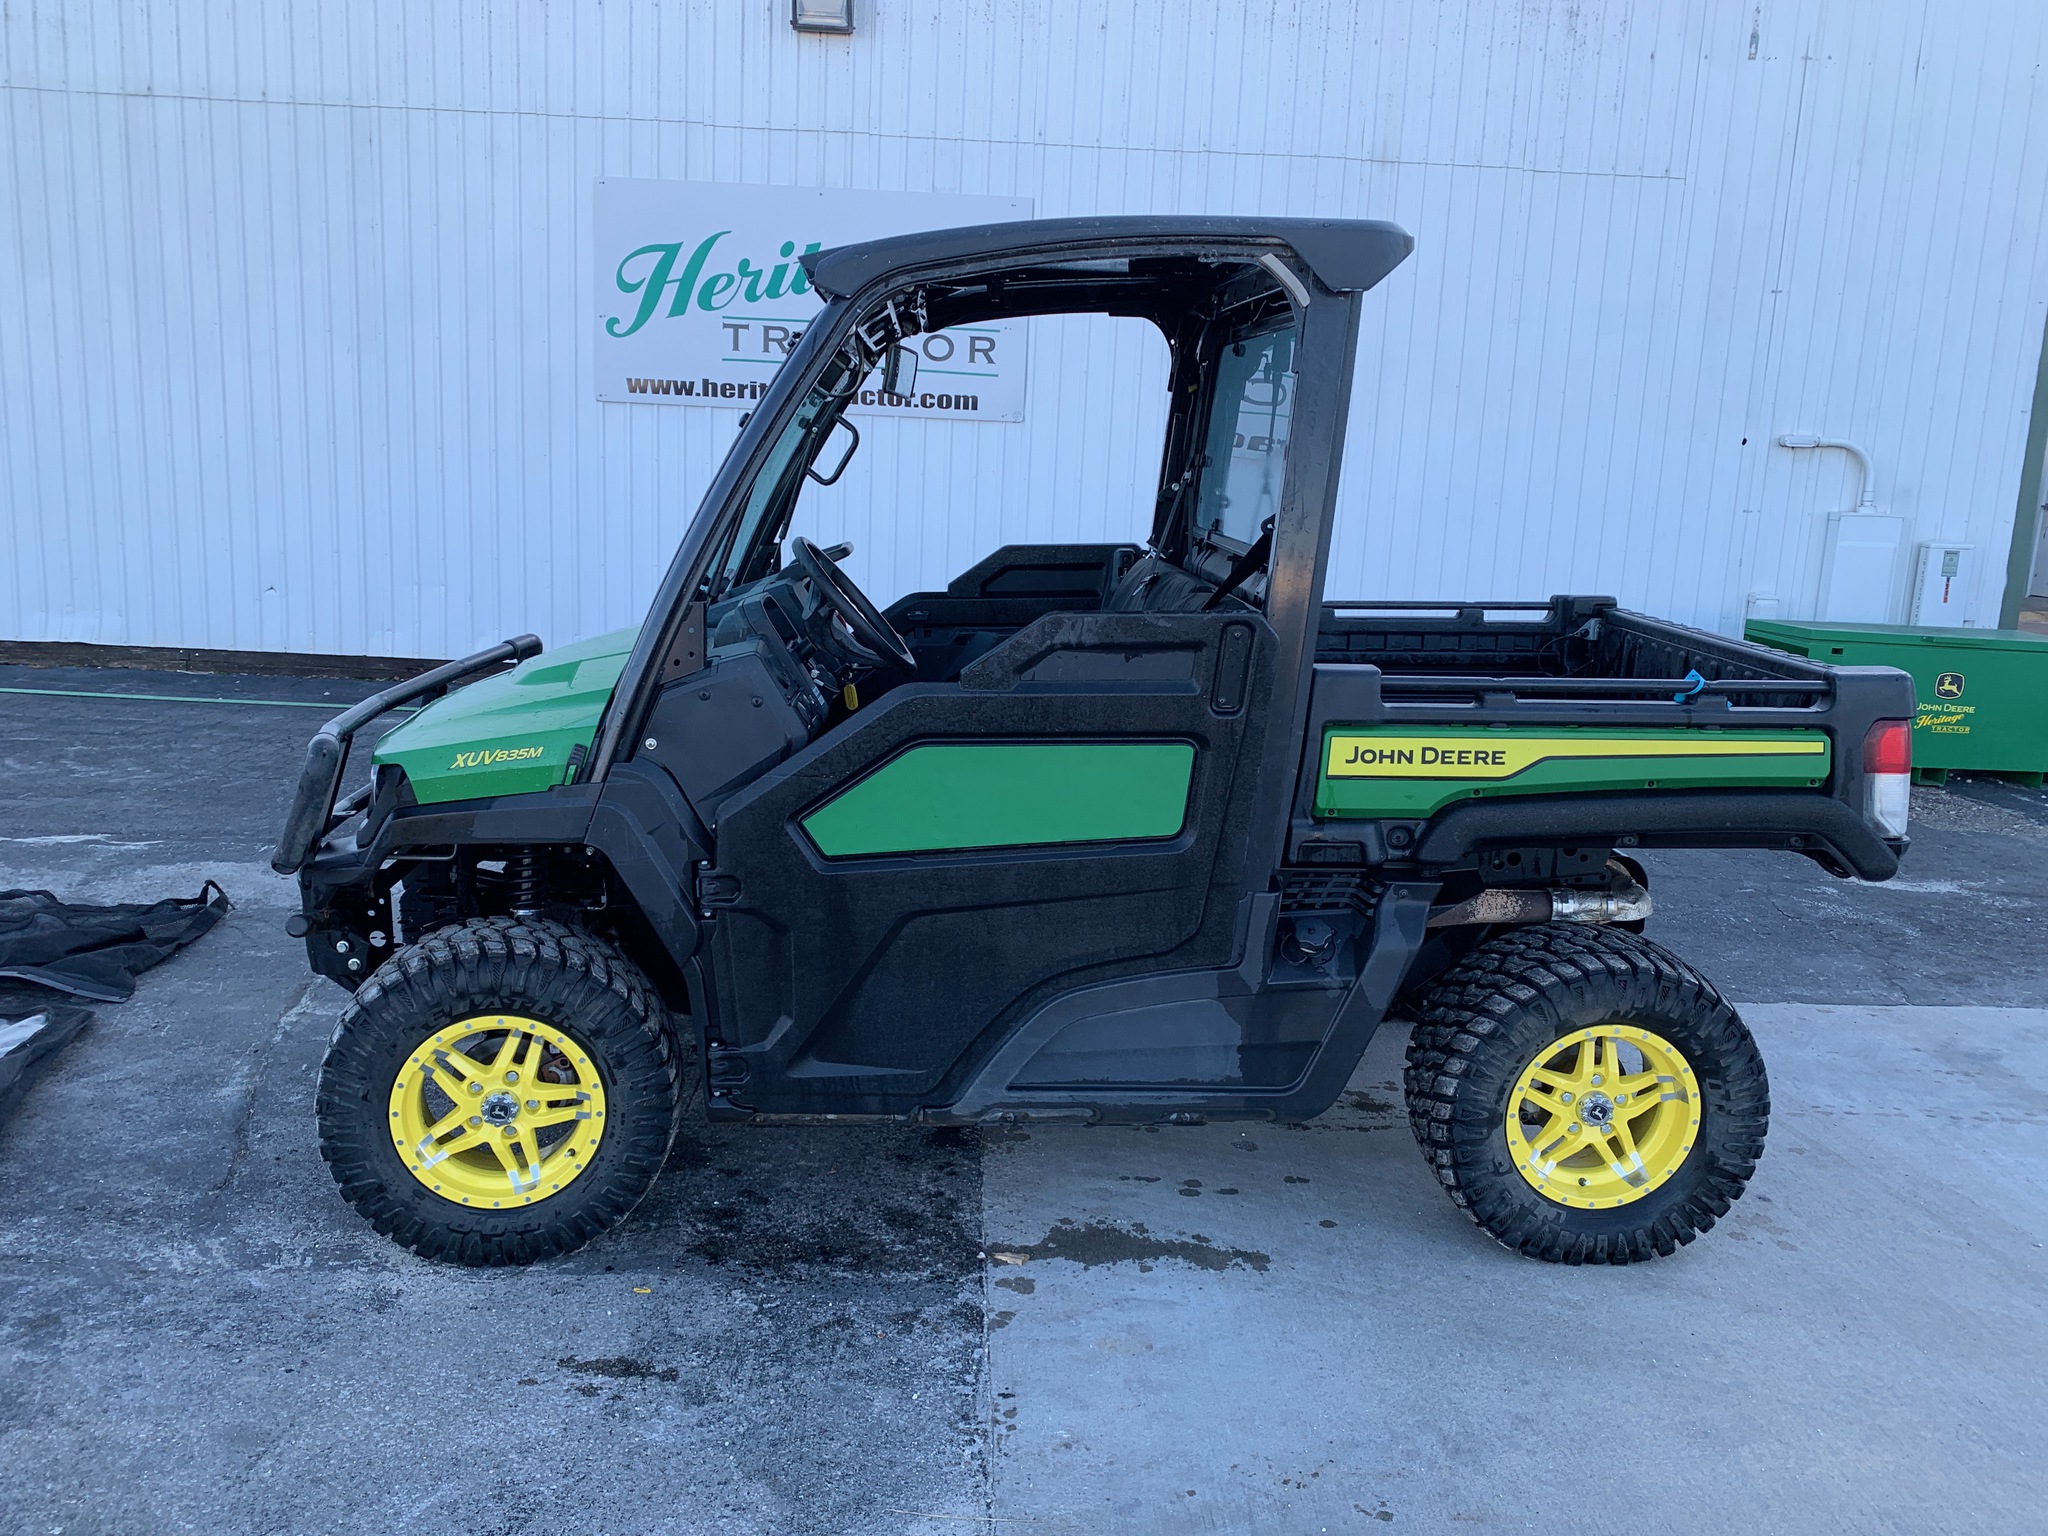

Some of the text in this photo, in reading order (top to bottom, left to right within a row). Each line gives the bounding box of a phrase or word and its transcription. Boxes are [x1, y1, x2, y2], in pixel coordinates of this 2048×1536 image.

[606, 231, 821, 337] Herit
[722, 322, 996, 364] TROR
[626, 377, 978, 411] www.heritcto.com
[1916, 702, 1976, 713] JOHN DEERE
[1914, 713, 1965, 729] Heritage
[1931, 725, 1970, 733] TRACTOR
[449, 746, 545, 770] XUV835M
[1345, 746, 1506, 766] JOHN DEERE
